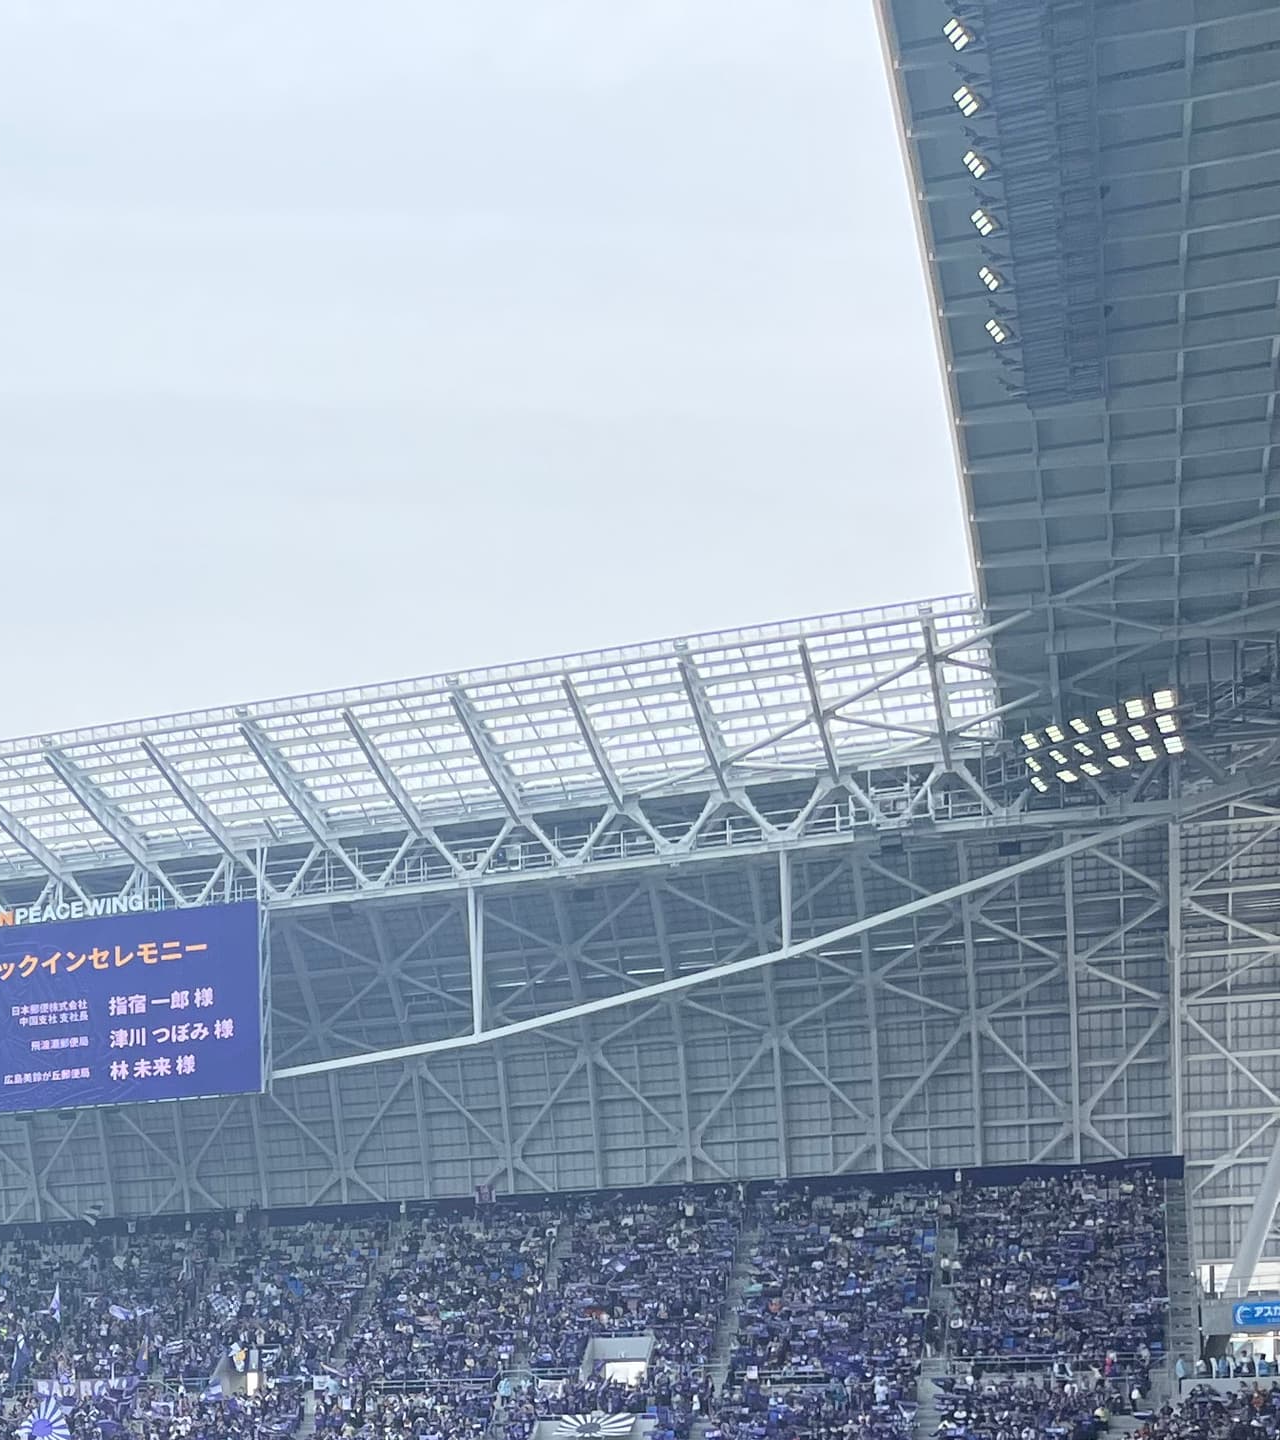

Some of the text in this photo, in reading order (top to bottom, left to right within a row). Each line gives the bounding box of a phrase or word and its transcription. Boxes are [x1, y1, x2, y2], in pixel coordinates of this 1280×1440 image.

[15, 901, 83, 926] PEACE
[86, 895, 144, 915] WING
[109, 987, 214, 1017] 指宿 一郎 様
[110, 1018, 234, 1049] 津川 つぼみ 様
[110, 1054, 196, 1081] 林 未来 様
